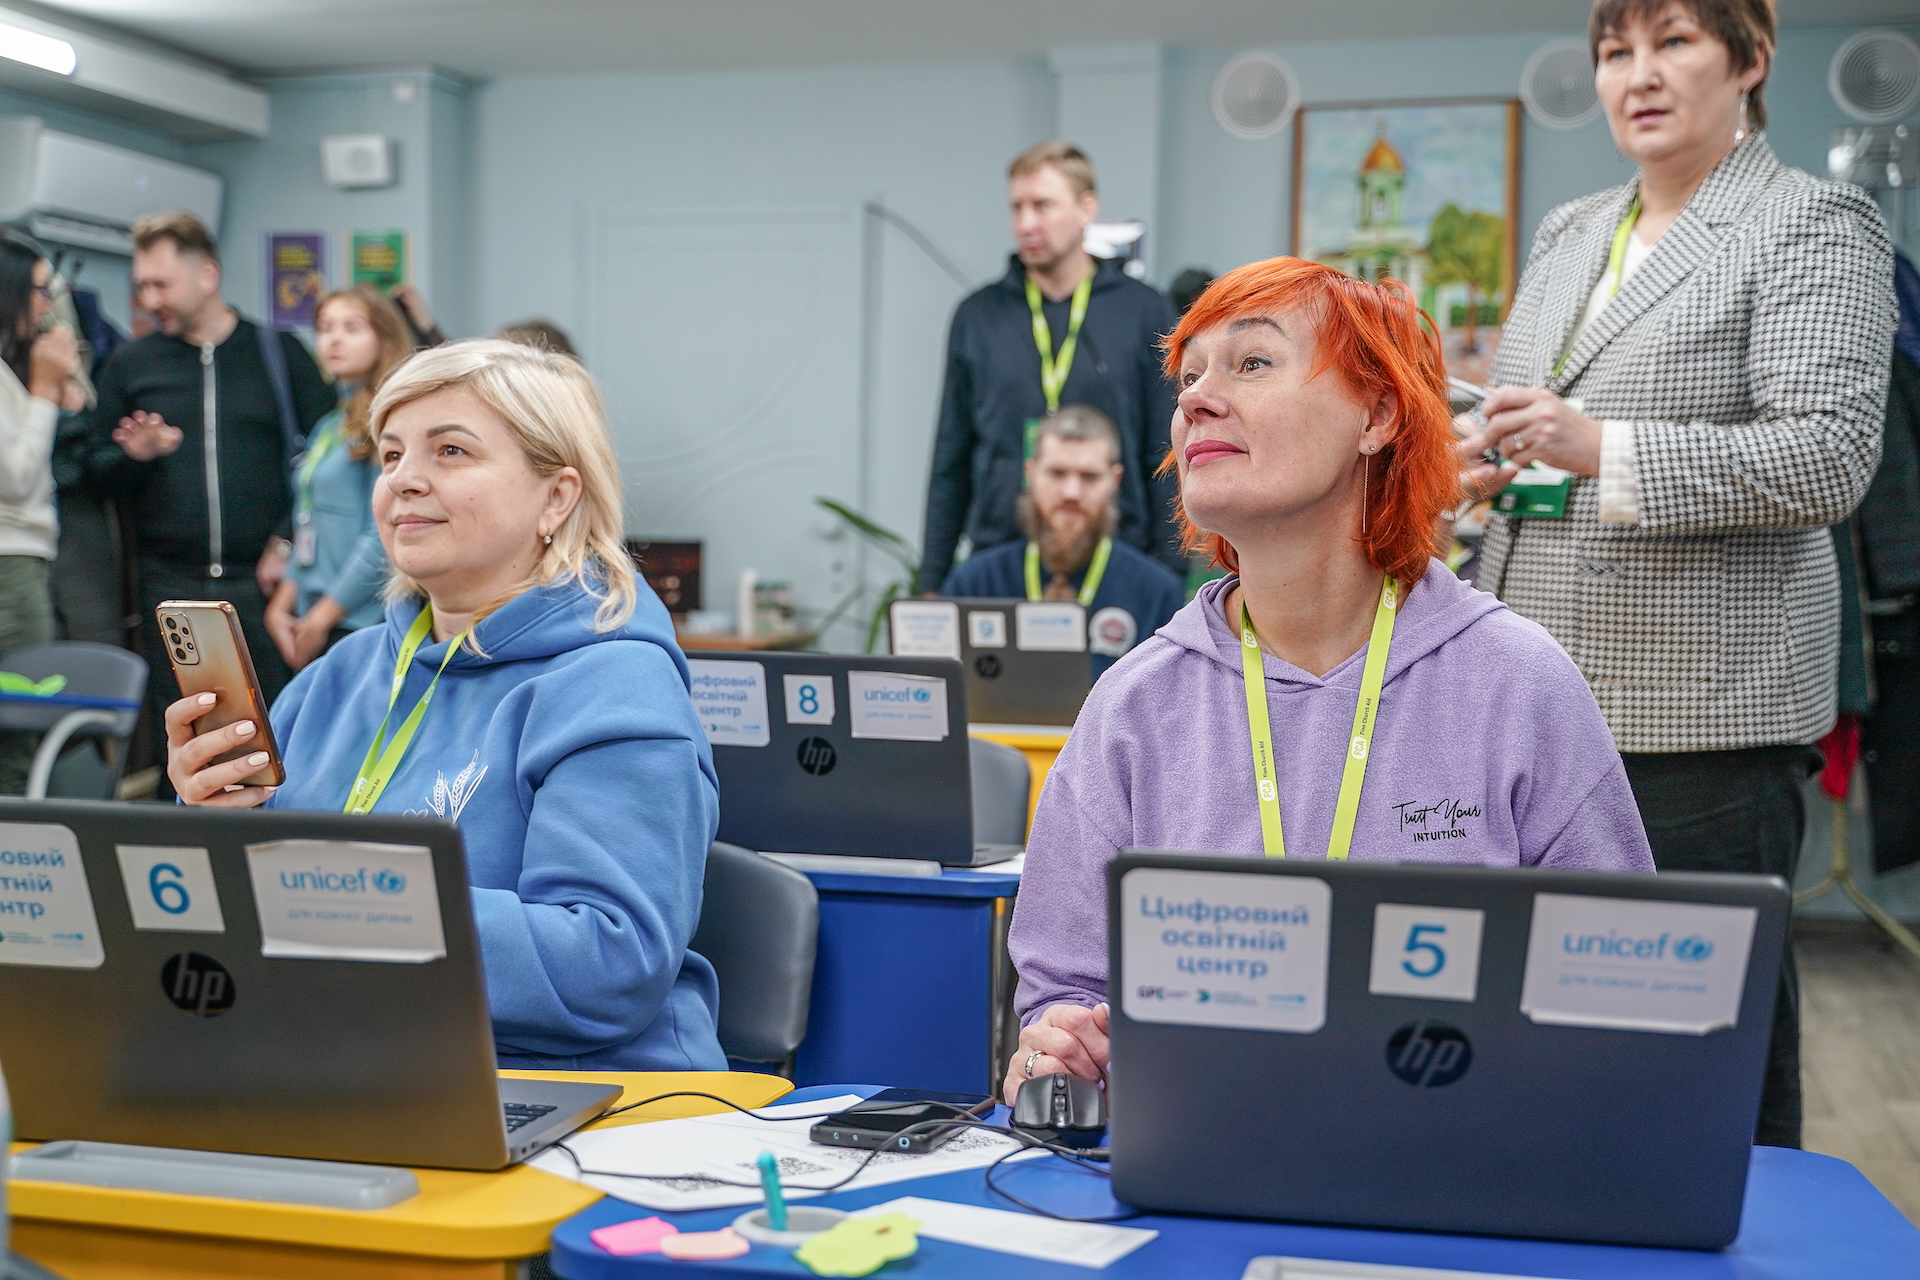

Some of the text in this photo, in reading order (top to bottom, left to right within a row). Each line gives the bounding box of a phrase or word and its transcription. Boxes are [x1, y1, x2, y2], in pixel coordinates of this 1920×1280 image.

[692, 674, 757, 688] ифровий
[863, 686, 911, 702] unicef
[798, 684, 819, 715] 8
[801, 737, 834, 776] hp
[1353, 740, 1366, 757] FCA
[1261, 781, 1273, 799] FCA
[1392, 798, 1481, 833] Trust Your
[1413, 828, 1467, 842] INTUITION
[0, 848, 66, 868] овий
[148, 862, 191, 915] 6
[279, 865, 368, 893] unicef
[1139, 894, 1311, 926] Цифровий
[1161, 926, 1288, 952] освітній
[1401, 923, 1447, 979] 5
[1562, 928, 1672, 960] unicef
[1176, 955, 1270, 981] центр
[168, 953, 232, 1017] hp
[1390, 1021, 1469, 1088] hp
